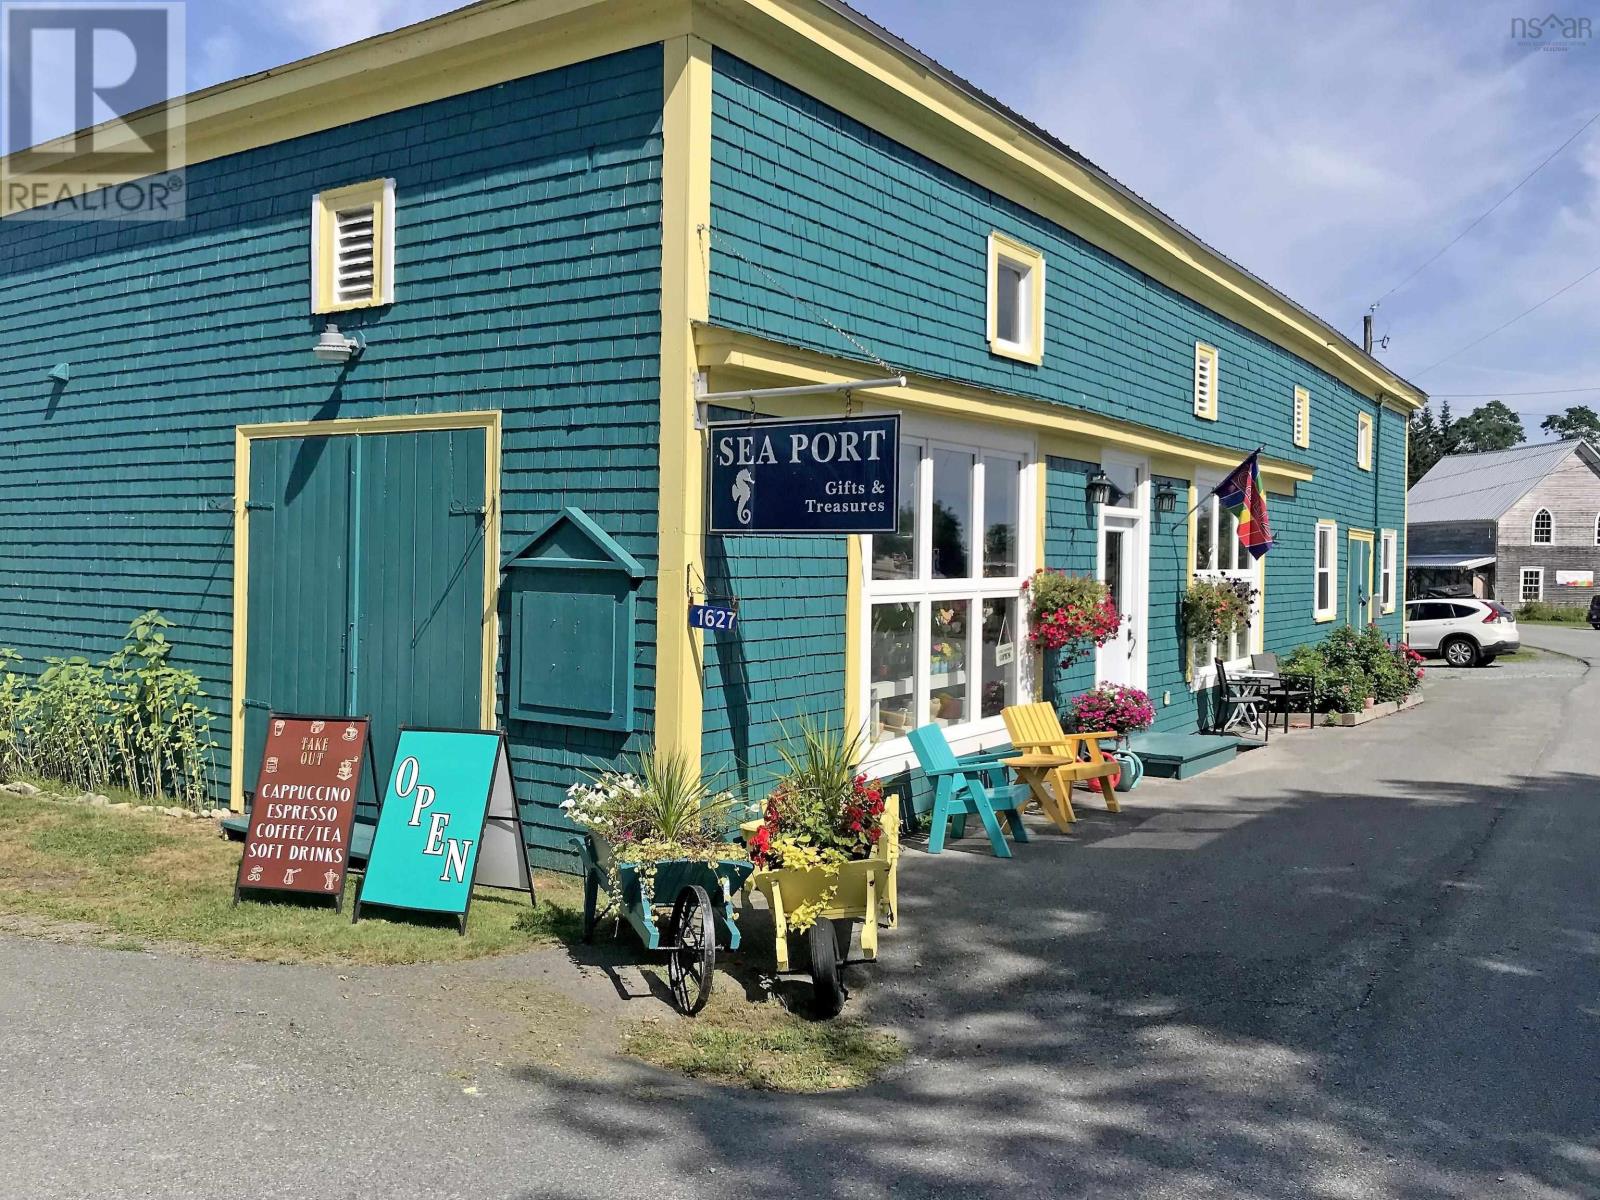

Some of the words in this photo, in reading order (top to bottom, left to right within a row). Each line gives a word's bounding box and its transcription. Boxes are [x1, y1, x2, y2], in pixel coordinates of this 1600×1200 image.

[719, 435, 778, 466] SEA
[789, 430, 886, 463] PORT
[825, 480, 865, 495] Gifts
[871, 480, 885, 494] &
[805, 499, 885, 513] Treasures
[697, 608, 736, 629] 1627
[301, 737, 328, 751] TAKE
[300, 752, 324, 765] OUT
[262, 783, 351, 802] CAPPUCCINO
[266, 803, 338, 821] ESPRESSO
[395, 756, 473, 883] OPEN
[256, 823, 342, 843] COFFEE/TEA
[248, 842, 284, 859] SOFT
[289, 845, 343, 863] DRINKS
